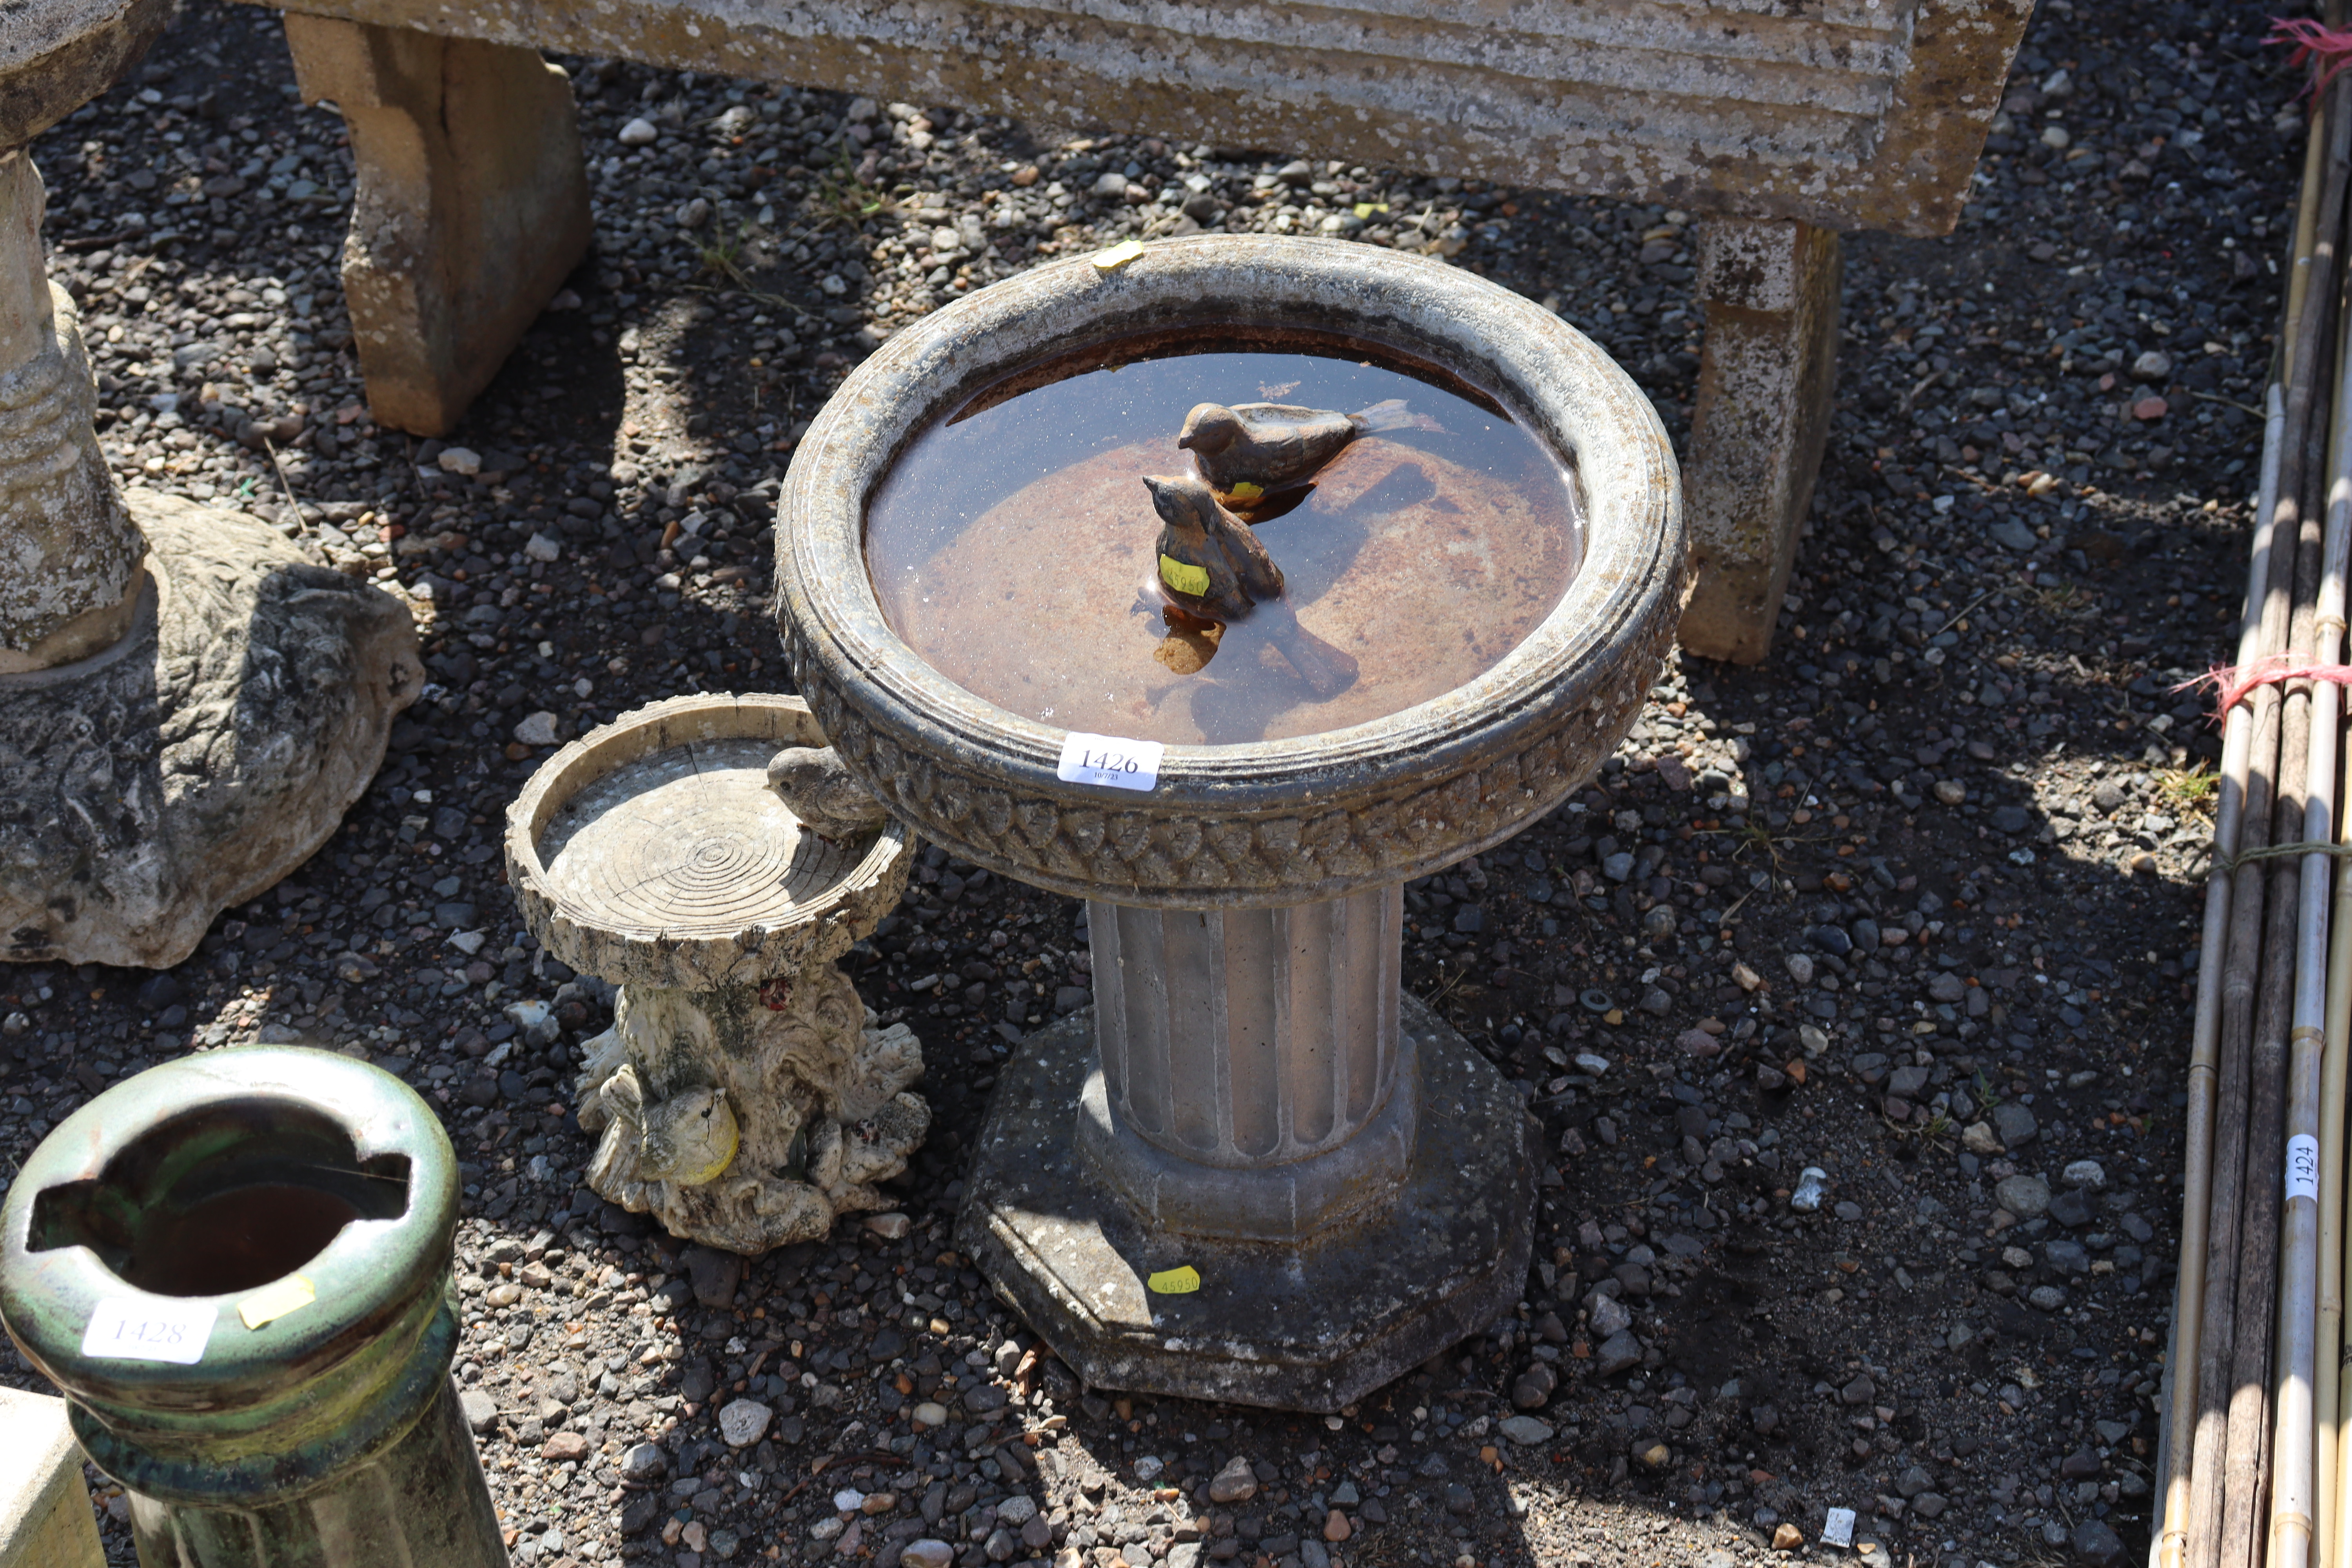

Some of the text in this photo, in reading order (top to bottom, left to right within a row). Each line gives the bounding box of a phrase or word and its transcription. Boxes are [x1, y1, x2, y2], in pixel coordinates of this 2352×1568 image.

[1079, 749, 1138, 774] 1426
[1094, 771, 1118, 781] 10/7/23
[2295, 1146, 2314, 1186] 1424
[1162, 1276, 1198, 1292] 45950
[112, 1319, 187, 1345] 1428
